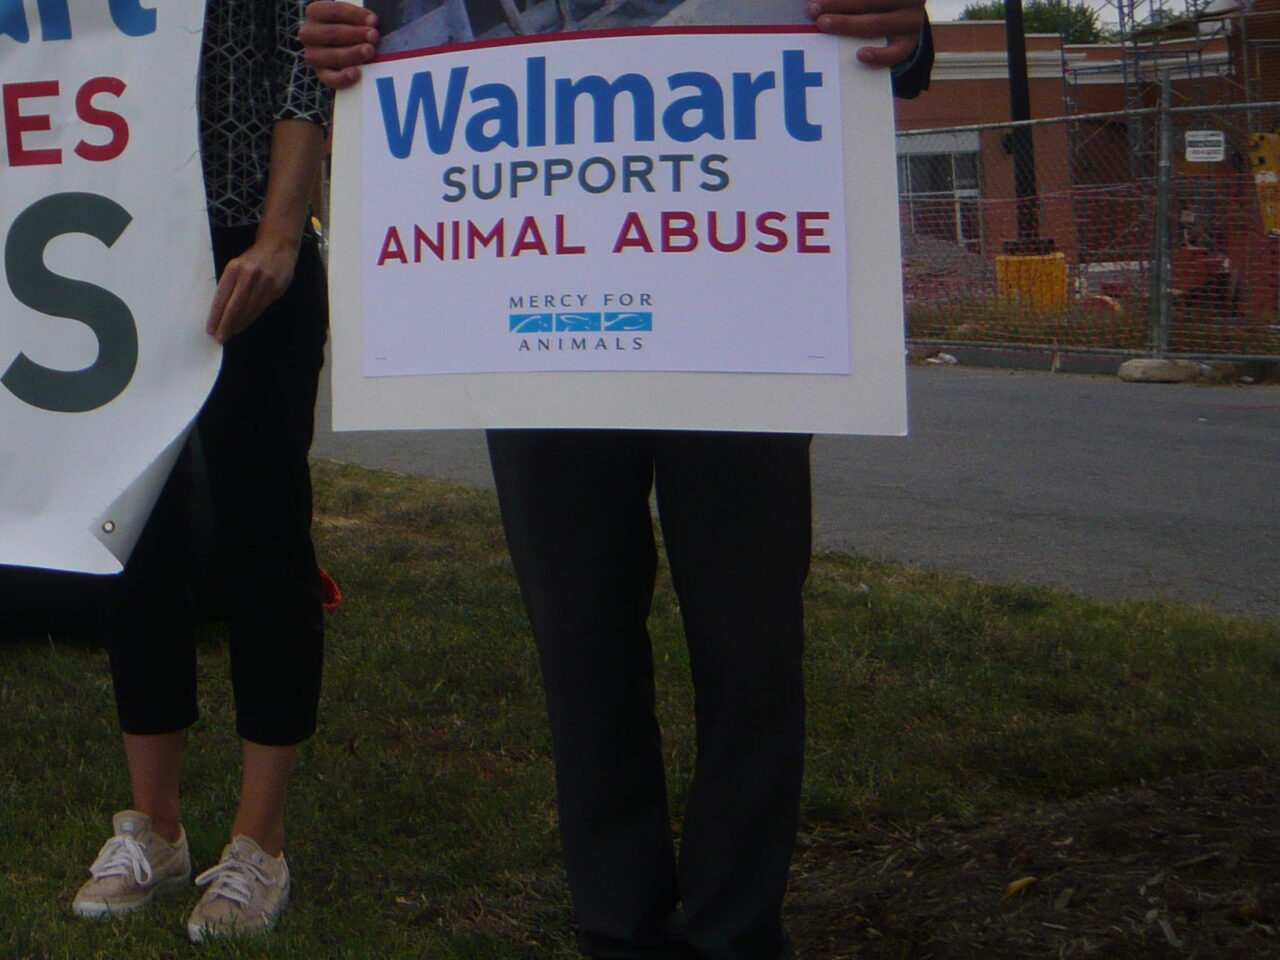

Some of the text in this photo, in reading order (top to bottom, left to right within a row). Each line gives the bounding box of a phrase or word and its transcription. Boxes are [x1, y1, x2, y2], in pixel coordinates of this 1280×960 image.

[375, 49, 823, 160] Walmart
[441, 153, 730, 202] SUPPORTS
[376, 210, 831, 266] ANIMAL ABUSE
[509, 292, 653, 308] MERCY FOR
[518, 337, 643, 352] ANIMALS
